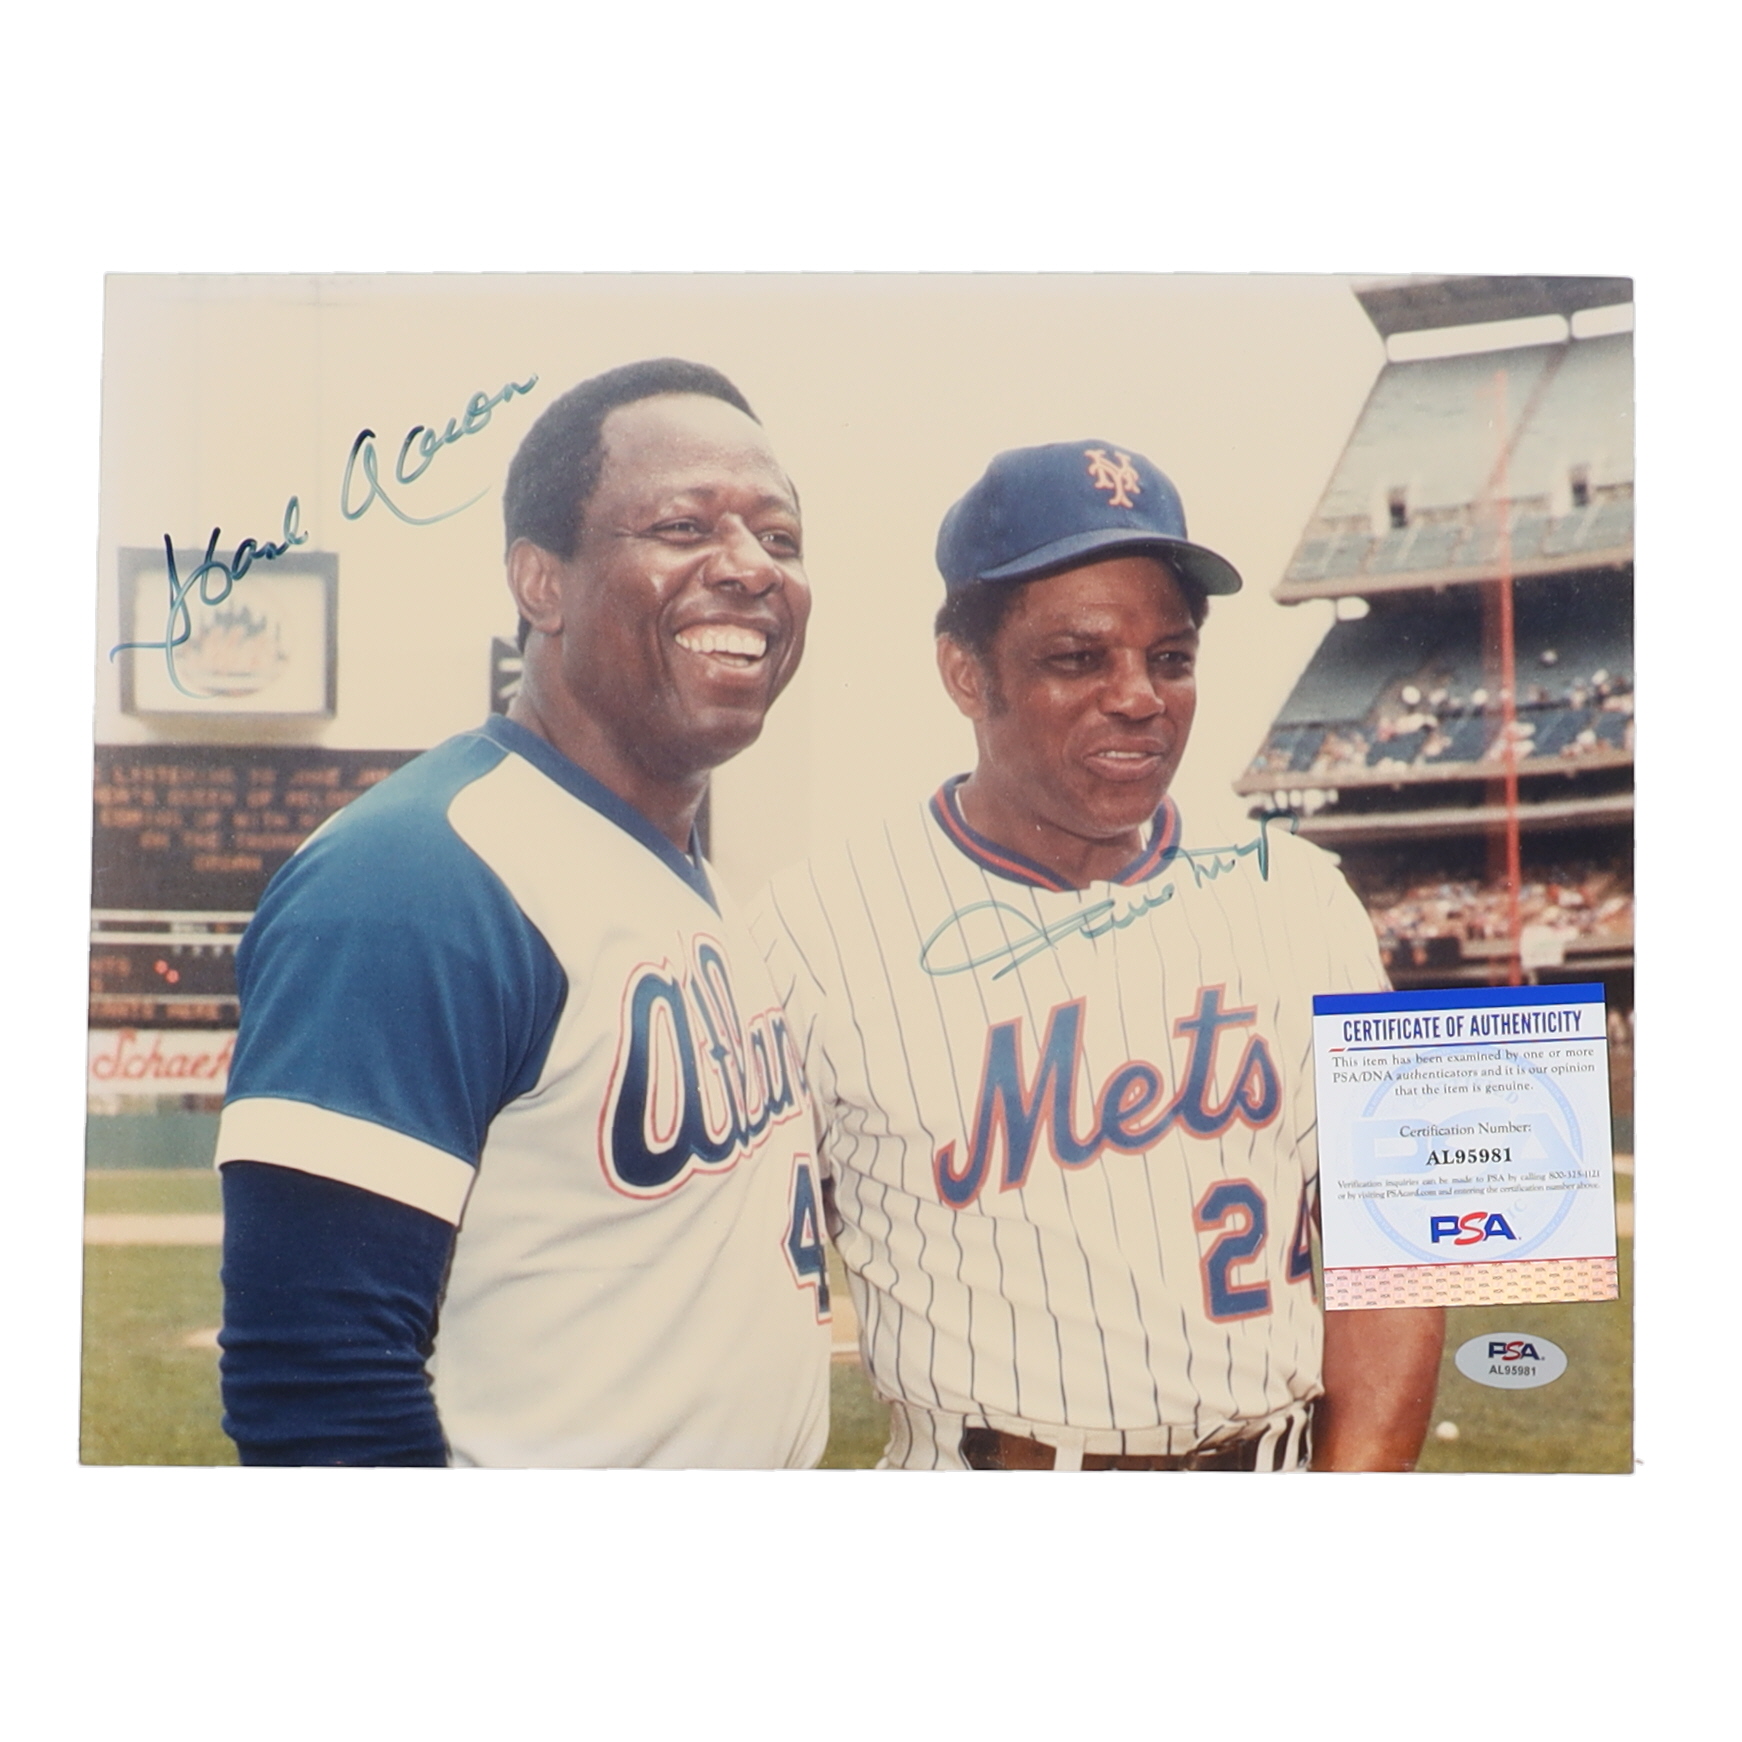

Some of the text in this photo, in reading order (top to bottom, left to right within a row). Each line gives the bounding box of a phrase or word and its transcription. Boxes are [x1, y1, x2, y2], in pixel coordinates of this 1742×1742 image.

[1084, 449, 1141, 508] NY
[1343, 1010, 1582, 1042] CERTIFICATE OF AUTHENTICITY
[1331, 1049, 1594, 1068] This item has been examined by one or more
[1333, 1062, 1595, 1083] PSA/DNA authenticators and it is our opinion
[934, 983, 1282, 1210] Mets
[1395, 1081, 1534, 1096] that the item is genuine.
[1399, 1121, 1532, 1138] Certification Number:
[1425, 1147, 1513, 1166] AL95981
[1487, 1174, 1505, 1182] PSA
[1508, 1173, 1517, 1182] by
[1520, 1172, 1546, 1181] calling
[1430, 1211, 1517, 1245] PSA
[1488, 1341, 1541, 1361] PSA
[1488, 1365, 1536, 1376] AL95981
